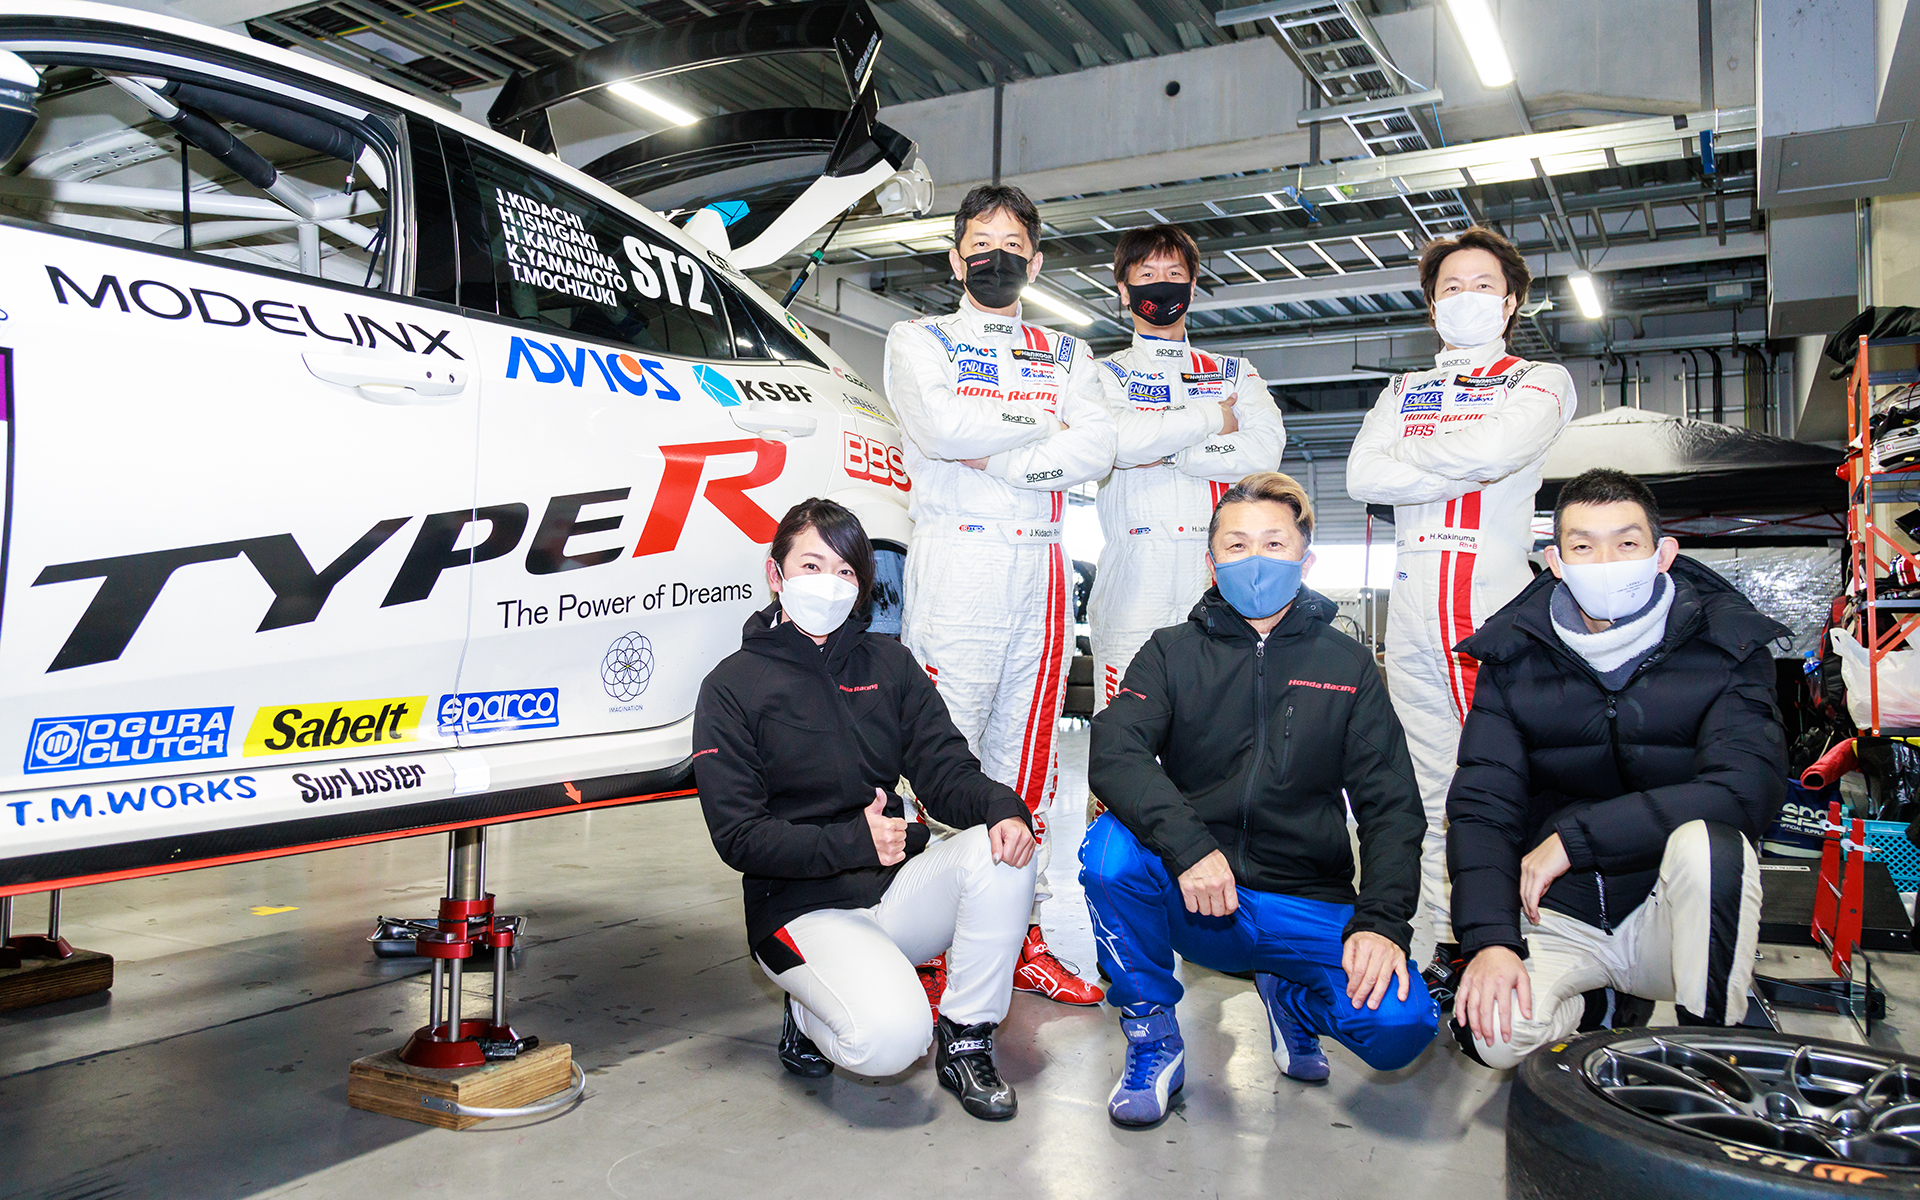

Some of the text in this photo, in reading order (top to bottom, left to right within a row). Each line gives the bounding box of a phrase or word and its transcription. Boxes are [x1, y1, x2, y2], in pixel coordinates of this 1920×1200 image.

[495, 187, 585, 231] J.KIDACHI
[498, 204, 599, 251] H.ISHIGAKI
[502, 222, 621, 274] H.KAKINUMA
[505, 241, 628, 292] K.YAMAMOTO
[508, 261, 618, 307] T.MOCHIZUKI
[622, 235, 714, 316] ST2
[45, 265, 465, 361] MODELINX
[983, 323, 1014, 334] sparco
[959, 361, 999, 375] ENDLESS
[735, 379, 814, 404] KSBF
[956, 385, 1058, 406] Hond Racing
[1130, 383, 1168, 397] ENDLESS
[1002, 412, 1037, 425] sparco
[1403, 424, 1435, 438] BBS
[1440, 412, 1487, 423] Racin
[843, 430, 910, 491] BBS
[1204, 444, 1236, 454] sprco
[1026, 468, 1064, 483] sparco
[30, 437, 787, 674] TYPE R
[1429, 533, 1476, 543] H.Kakinuma
[497, 582, 753, 629] The Power of Dreams
[1288, 679, 1357, 694] Honda Racing
[87, 712, 227, 736] OGURA
[263, 702, 409, 752] Sabelt
[441, 691, 556, 732] sparco
[82, 733, 225, 765] CLUTCH
[291, 761, 427, 804] SurLuster
[7, 775, 258, 827] T.M.WORKS
